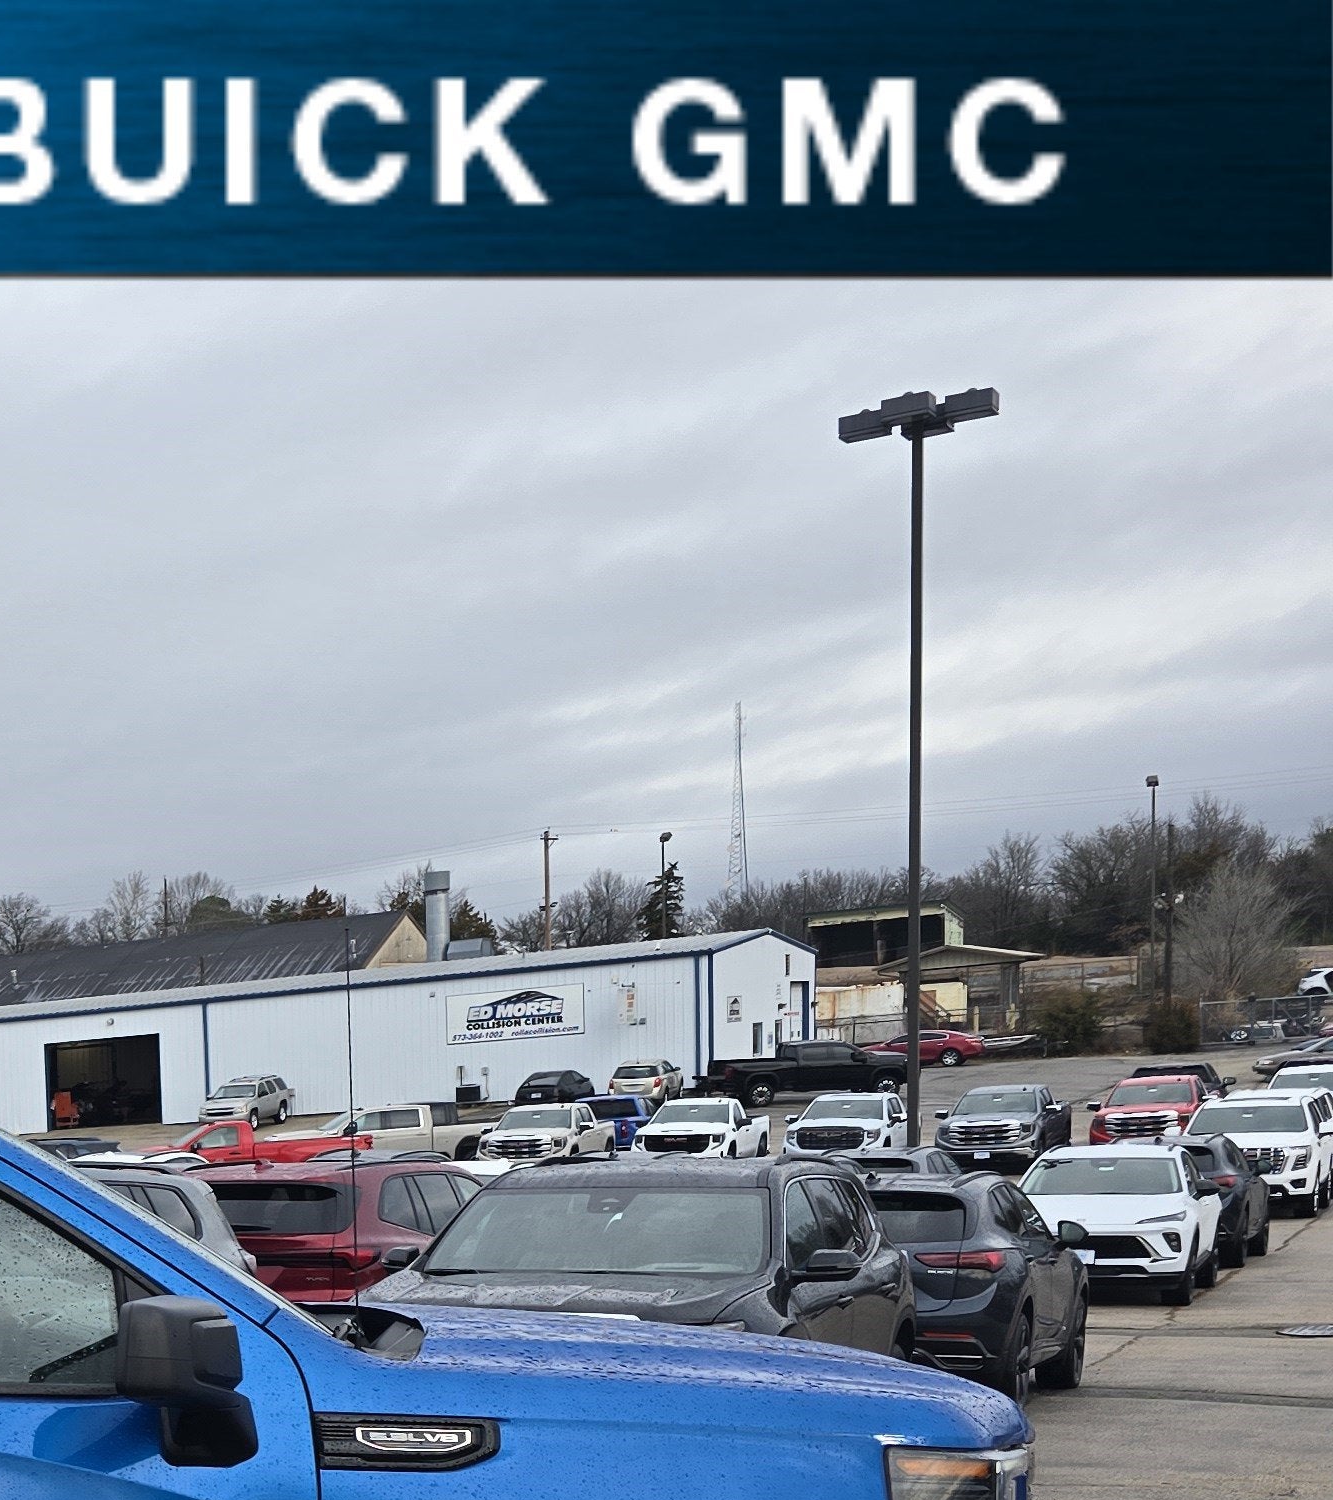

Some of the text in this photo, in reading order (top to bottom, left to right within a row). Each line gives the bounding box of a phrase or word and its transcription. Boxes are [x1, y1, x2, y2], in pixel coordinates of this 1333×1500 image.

[468, 999, 563, 1021] ED MORSE
[466, 1015, 563, 1031] COLLISION CENTER
